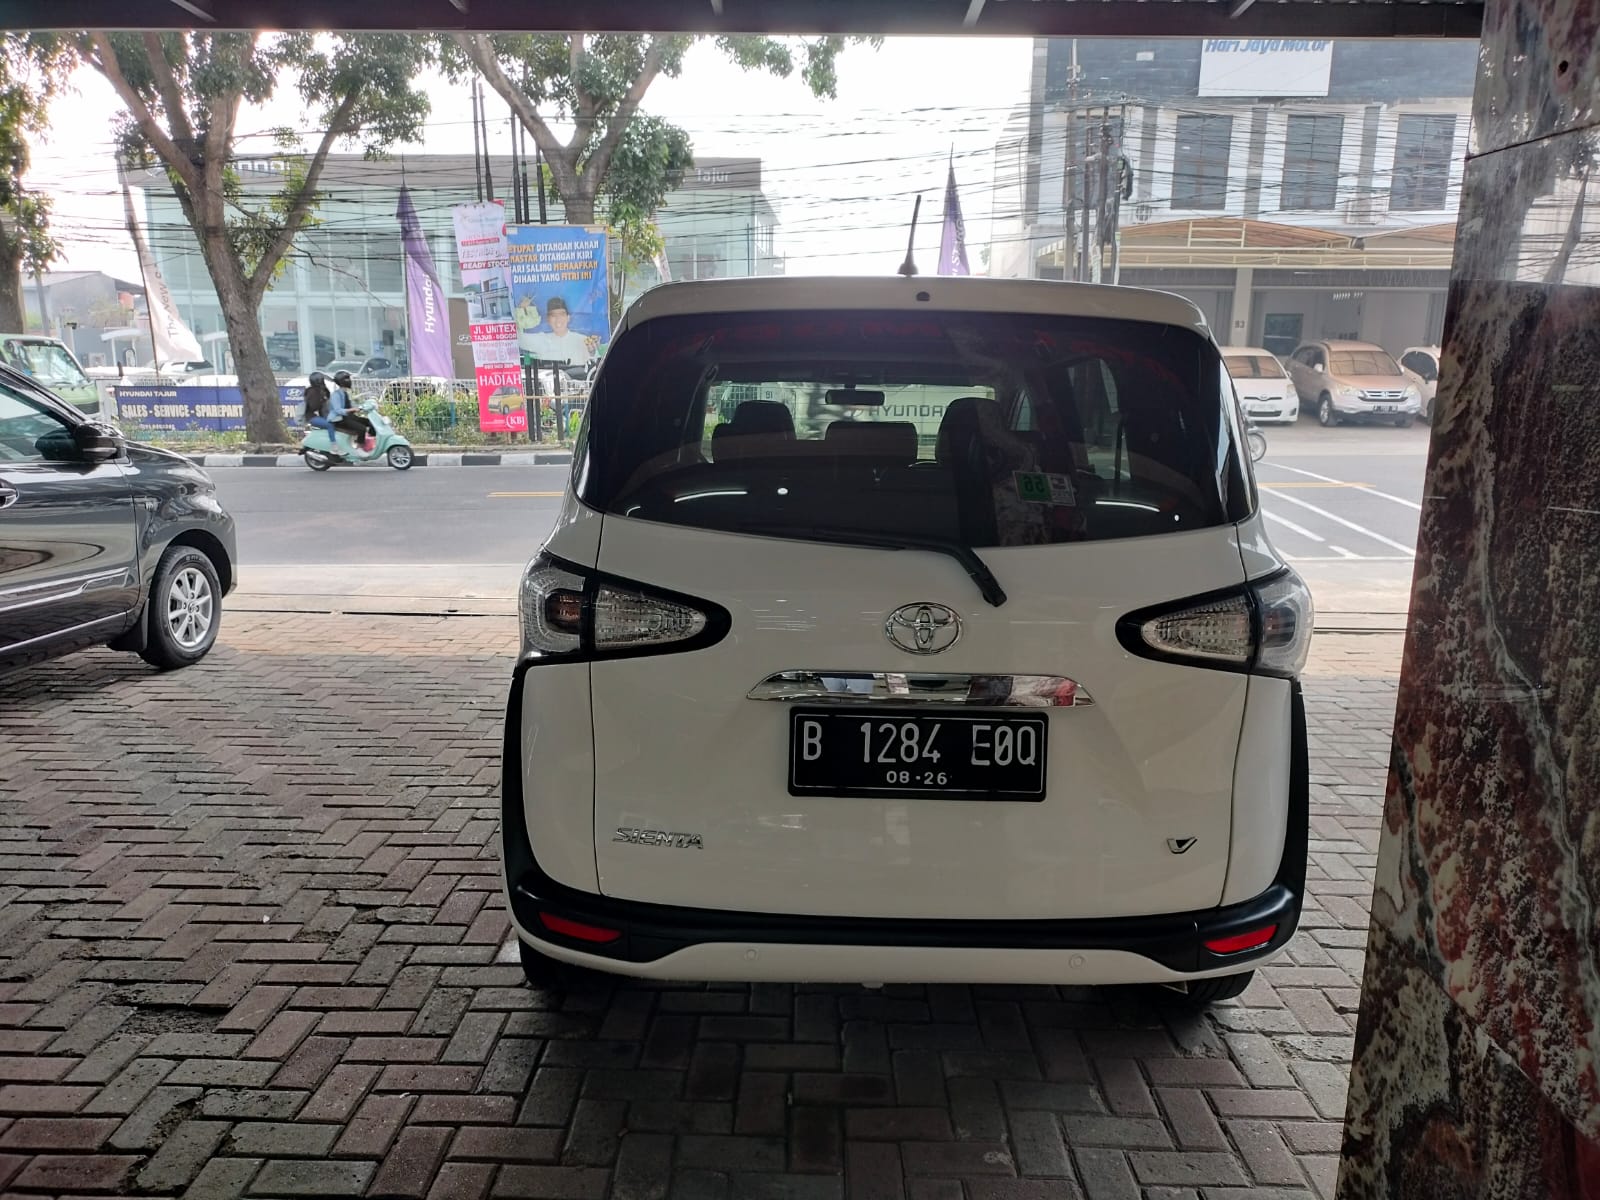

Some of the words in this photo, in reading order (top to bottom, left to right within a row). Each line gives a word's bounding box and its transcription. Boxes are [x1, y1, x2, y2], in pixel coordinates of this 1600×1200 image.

[695, 167, 730, 184] Tajur
[536, 242, 572, 252] DITANGAN
[574, 240, 599, 250] KANAN
[539, 251, 575, 262] DITANGAN
[577, 250, 593, 260] KIRI
[463, 261, 486, 270] READY
[487, 259, 510, 268] STOCK
[526, 263, 552, 273] SALING
[554, 260, 598, 271] MEMAAFKAN
[514, 274, 540, 284] DIHARI
[541, 273, 560, 283] YANG
[562, 272, 579, 281] FITRI
[581, 271, 592, 280] INI
[423, 273, 436, 333] Hyundai
[486, 324, 516, 334] UNITEX
[480, 374, 522, 386] HADIAH
[122, 404, 148, 417] SALES
[154, 404, 190, 417] SERVICE
[195, 404, 243, 418] SPAREPART
[869, 404, 944, 417] HYUNDA
[803, 721, 822, 761] B
[860, 722, 941, 763] 1284
[612, 827, 704, 849] SIENTA
